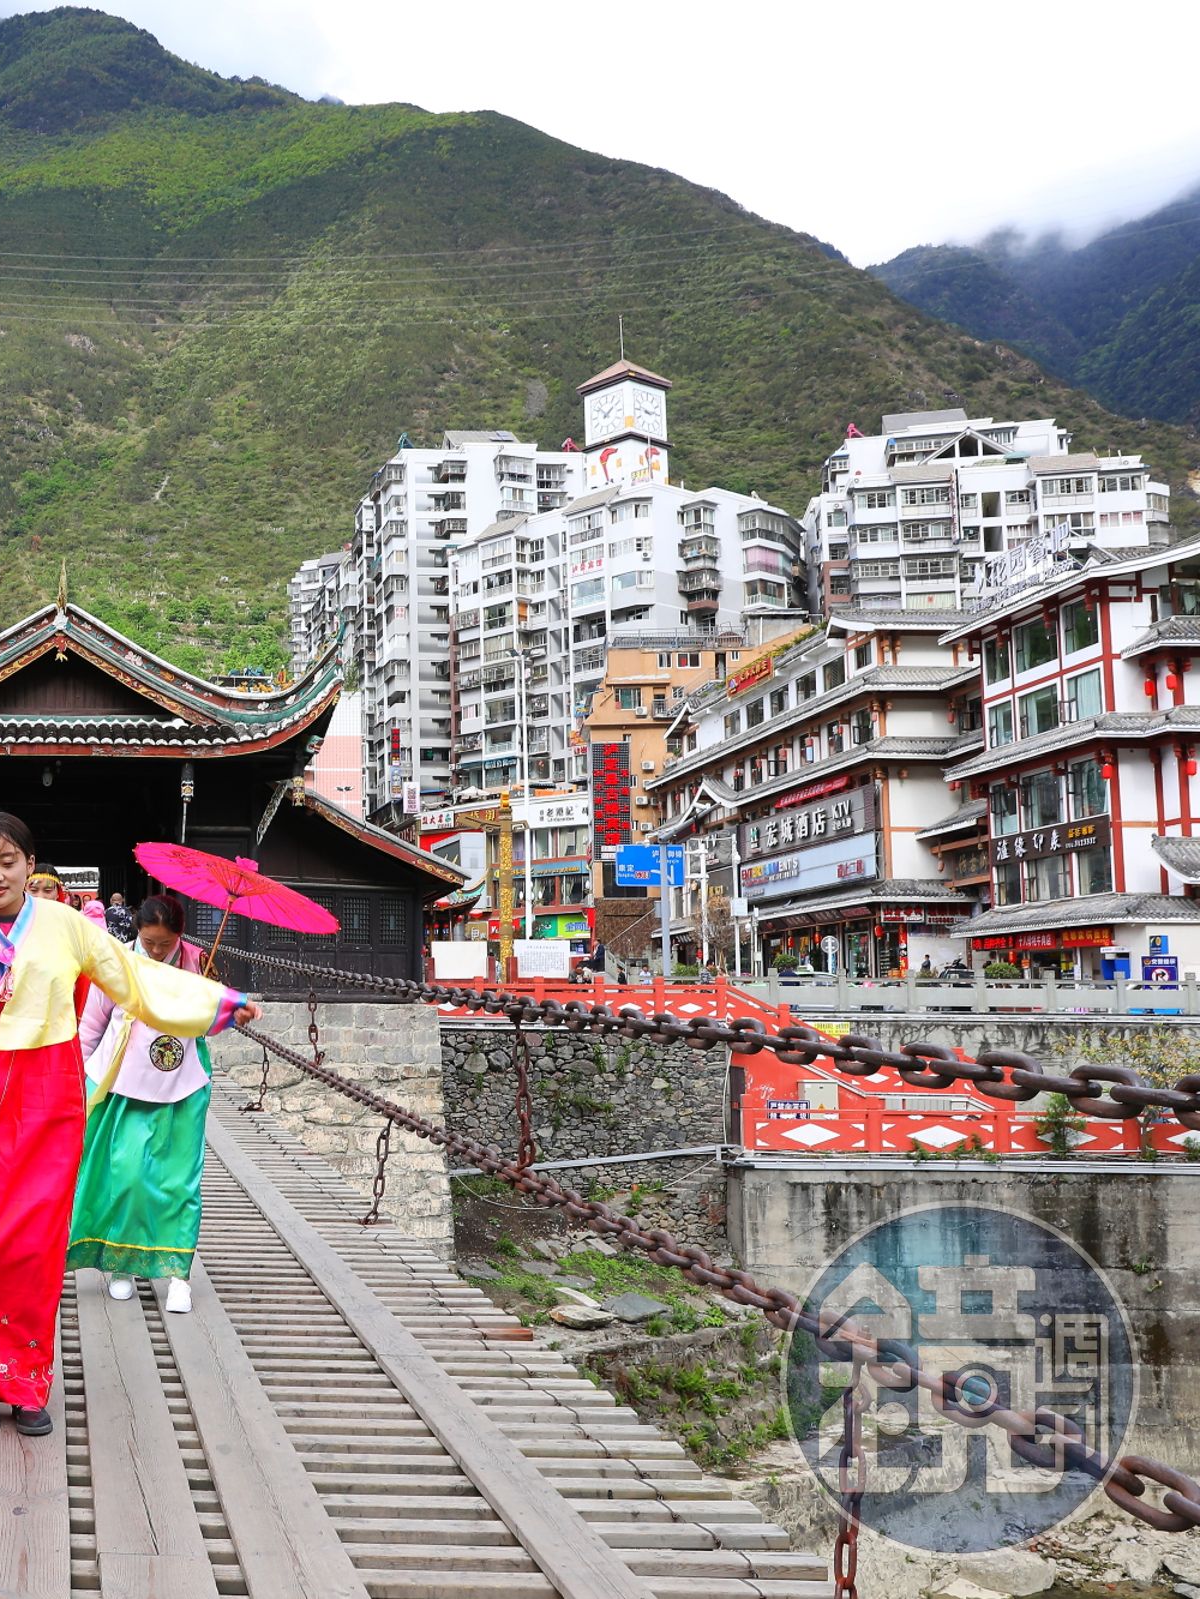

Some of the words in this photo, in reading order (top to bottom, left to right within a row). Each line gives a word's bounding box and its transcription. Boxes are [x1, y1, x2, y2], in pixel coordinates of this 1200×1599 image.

[831, 800, 851, 820] KTV
[765, 807, 827, 848] 宏城酒店
